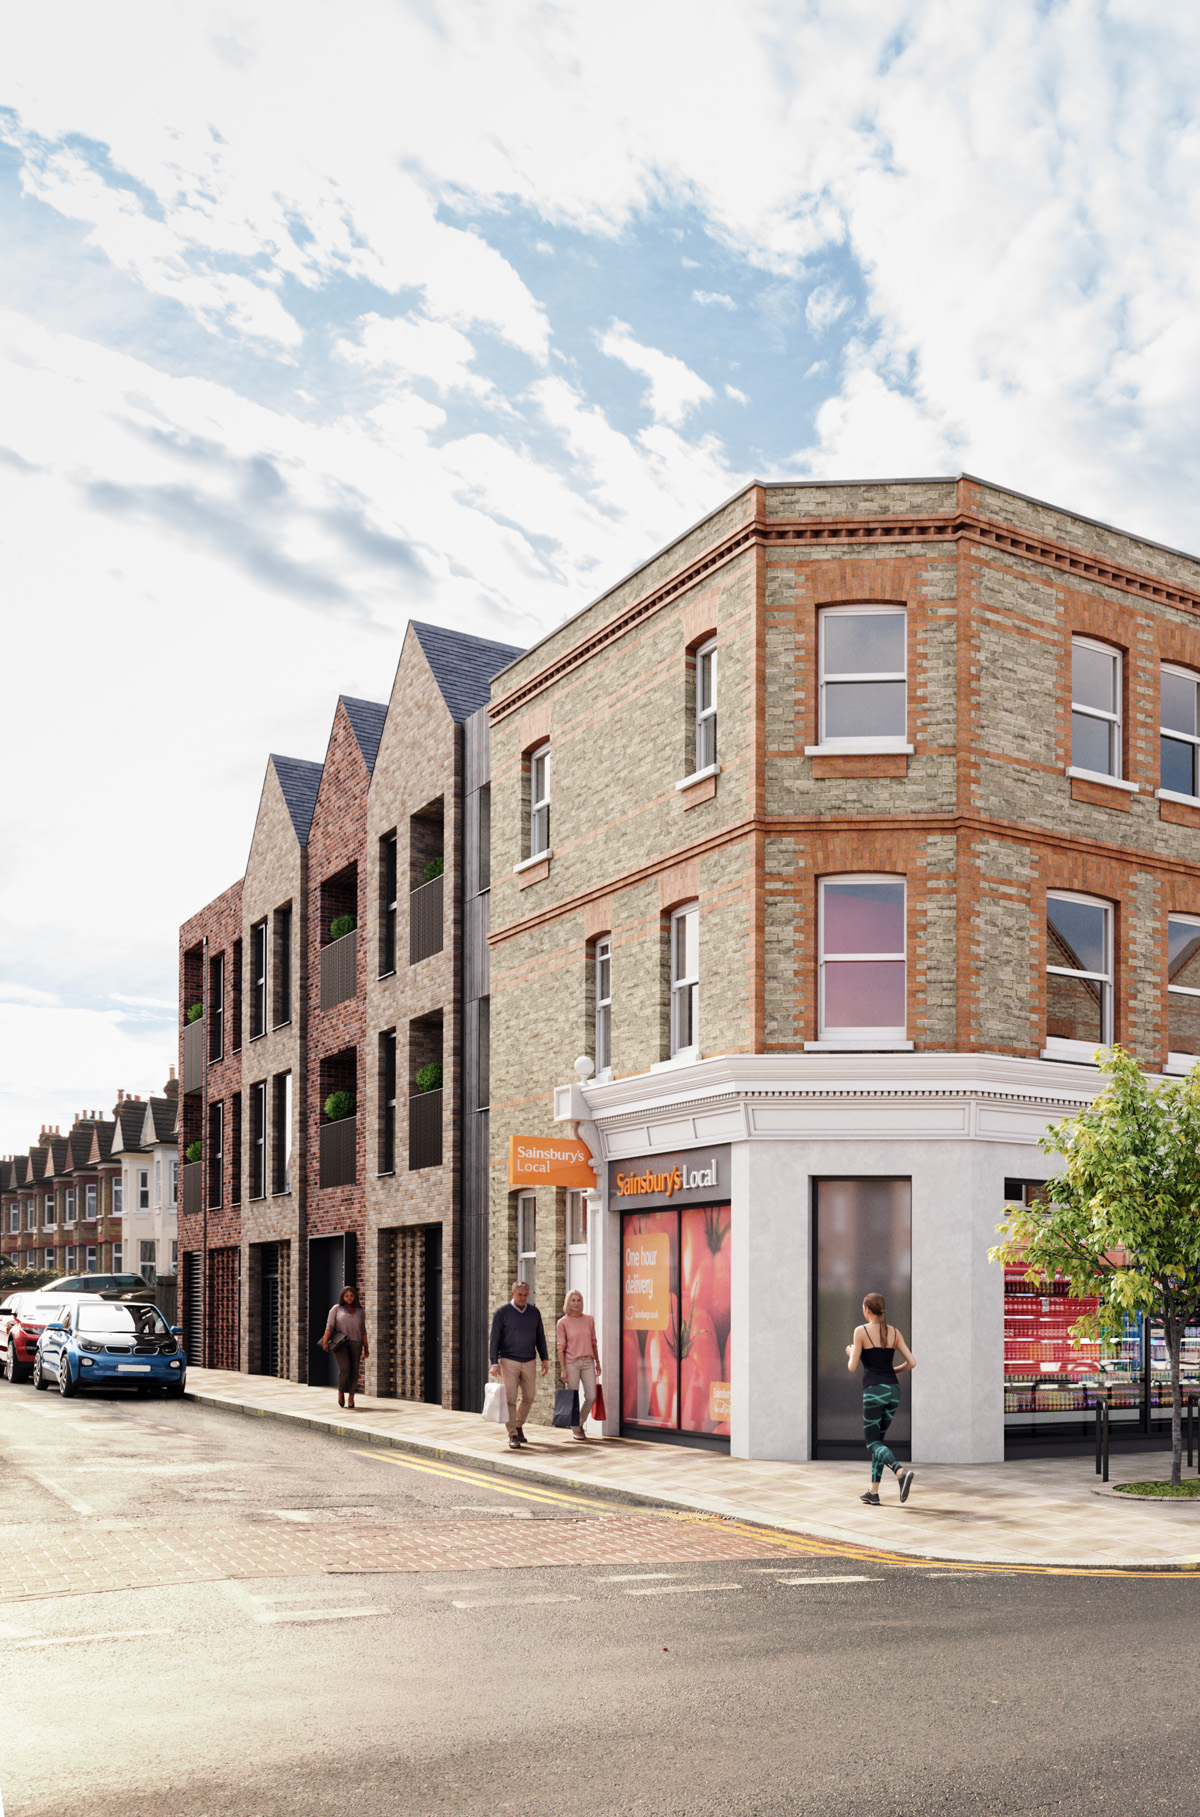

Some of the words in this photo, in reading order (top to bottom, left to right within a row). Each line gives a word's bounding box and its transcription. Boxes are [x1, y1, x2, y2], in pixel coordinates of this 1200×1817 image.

[517, 1146, 584, 1164] Sainsbury's
[517, 1159, 551, 1173] Local
[617, 1165, 683, 1197] Sainsbury's
[683, 1159, 718, 1189] Local
[625, 1248, 639, 1267] One
[640, 1245, 658, 1266] hour
[625, 1274, 653, 1300] delivery
